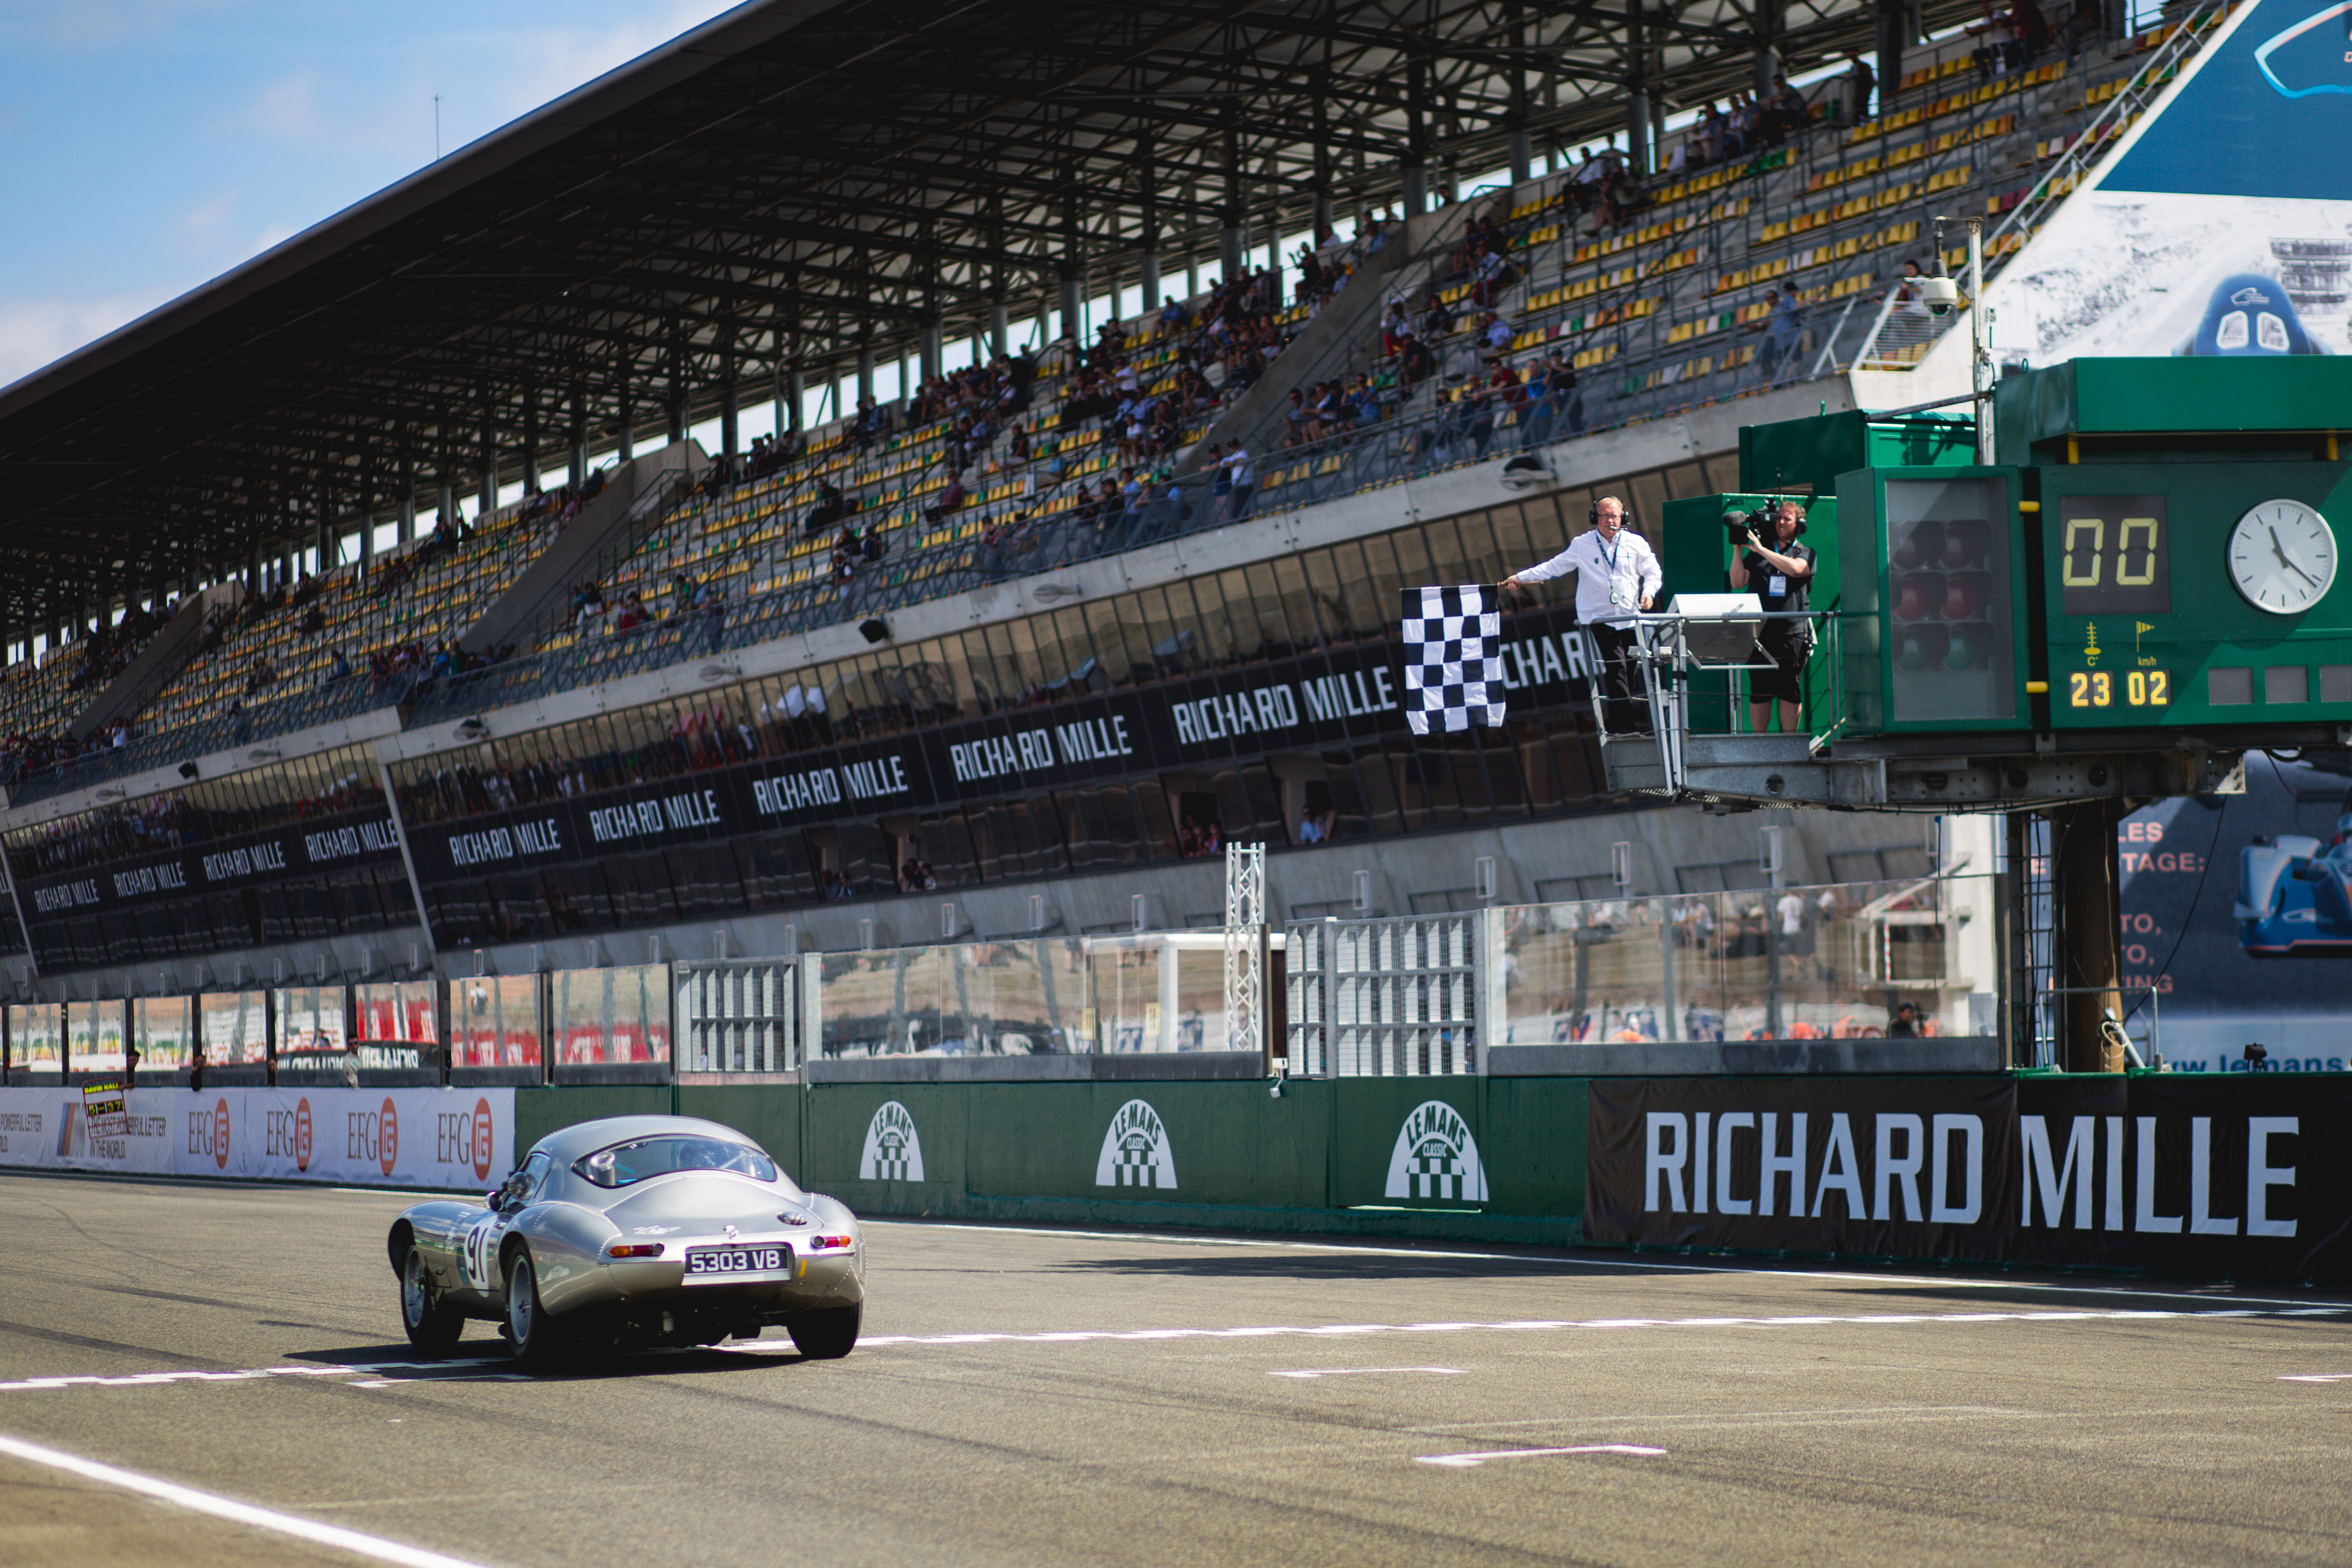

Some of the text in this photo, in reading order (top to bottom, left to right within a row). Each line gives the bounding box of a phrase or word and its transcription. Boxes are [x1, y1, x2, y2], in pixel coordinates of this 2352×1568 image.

[2063, 518, 2158, 586] 00
[2138, 656, 2156, 666] km/h
[1173, 667, 1397, 743] RICHARD MILLE
[2071, 672, 2110, 707] 23
[2128, 671, 2167, 705] 02
[951, 715, 1132, 781] RICHARD MILLE
[754, 756, 908, 814] RICHARD MILLE
[590, 790, 719, 841] RICHARD MILLE
[2118, 822, 2163, 843] ES
[306, 818, 399, 861] RICHARD MILLE
[450, 819, 560, 865] RICHARD MILLE
[114, 862, 185, 897] RICHARD MILLE
[203, 841, 285, 881] RICHARD MILLE
[2119, 853, 2206, 874] TAGE:
[34, 879, 99, 912] RICHARD MILLE
[2121, 944, 2155, 967] O,
[2121, 974, 2173, 995] ING
[84, 1085, 102, 1093] DAVID
[0, 1114, 42, 1132] POWERFUL LETTER
[91, 1116, 166, 1137] THE MOST POWERFUL LETTER
[188, 1110, 213, 1155] EFG
[266, 1110, 293, 1157] EFG
[348, 1111, 377, 1161] EFG
[437, 1112, 470, 1164] EFG
[874, 1104, 912, 1143] LE MANS
[1115, 1103, 1161, 1146] LE MANS
[1406, 1105, 1467, 1153] LE MANS
[90, 1140, 126, 1159] IN THE WORLD.
[1127, 1137, 1146, 1149] CLASSIC
[1423, 1142, 1447, 1157] CLASSIC
[1644, 1112, 2300, 1238] RICHARD MILLE
[468, 1226, 488, 1283] 91
[691, 1250, 780, 1272] 5303 VB
